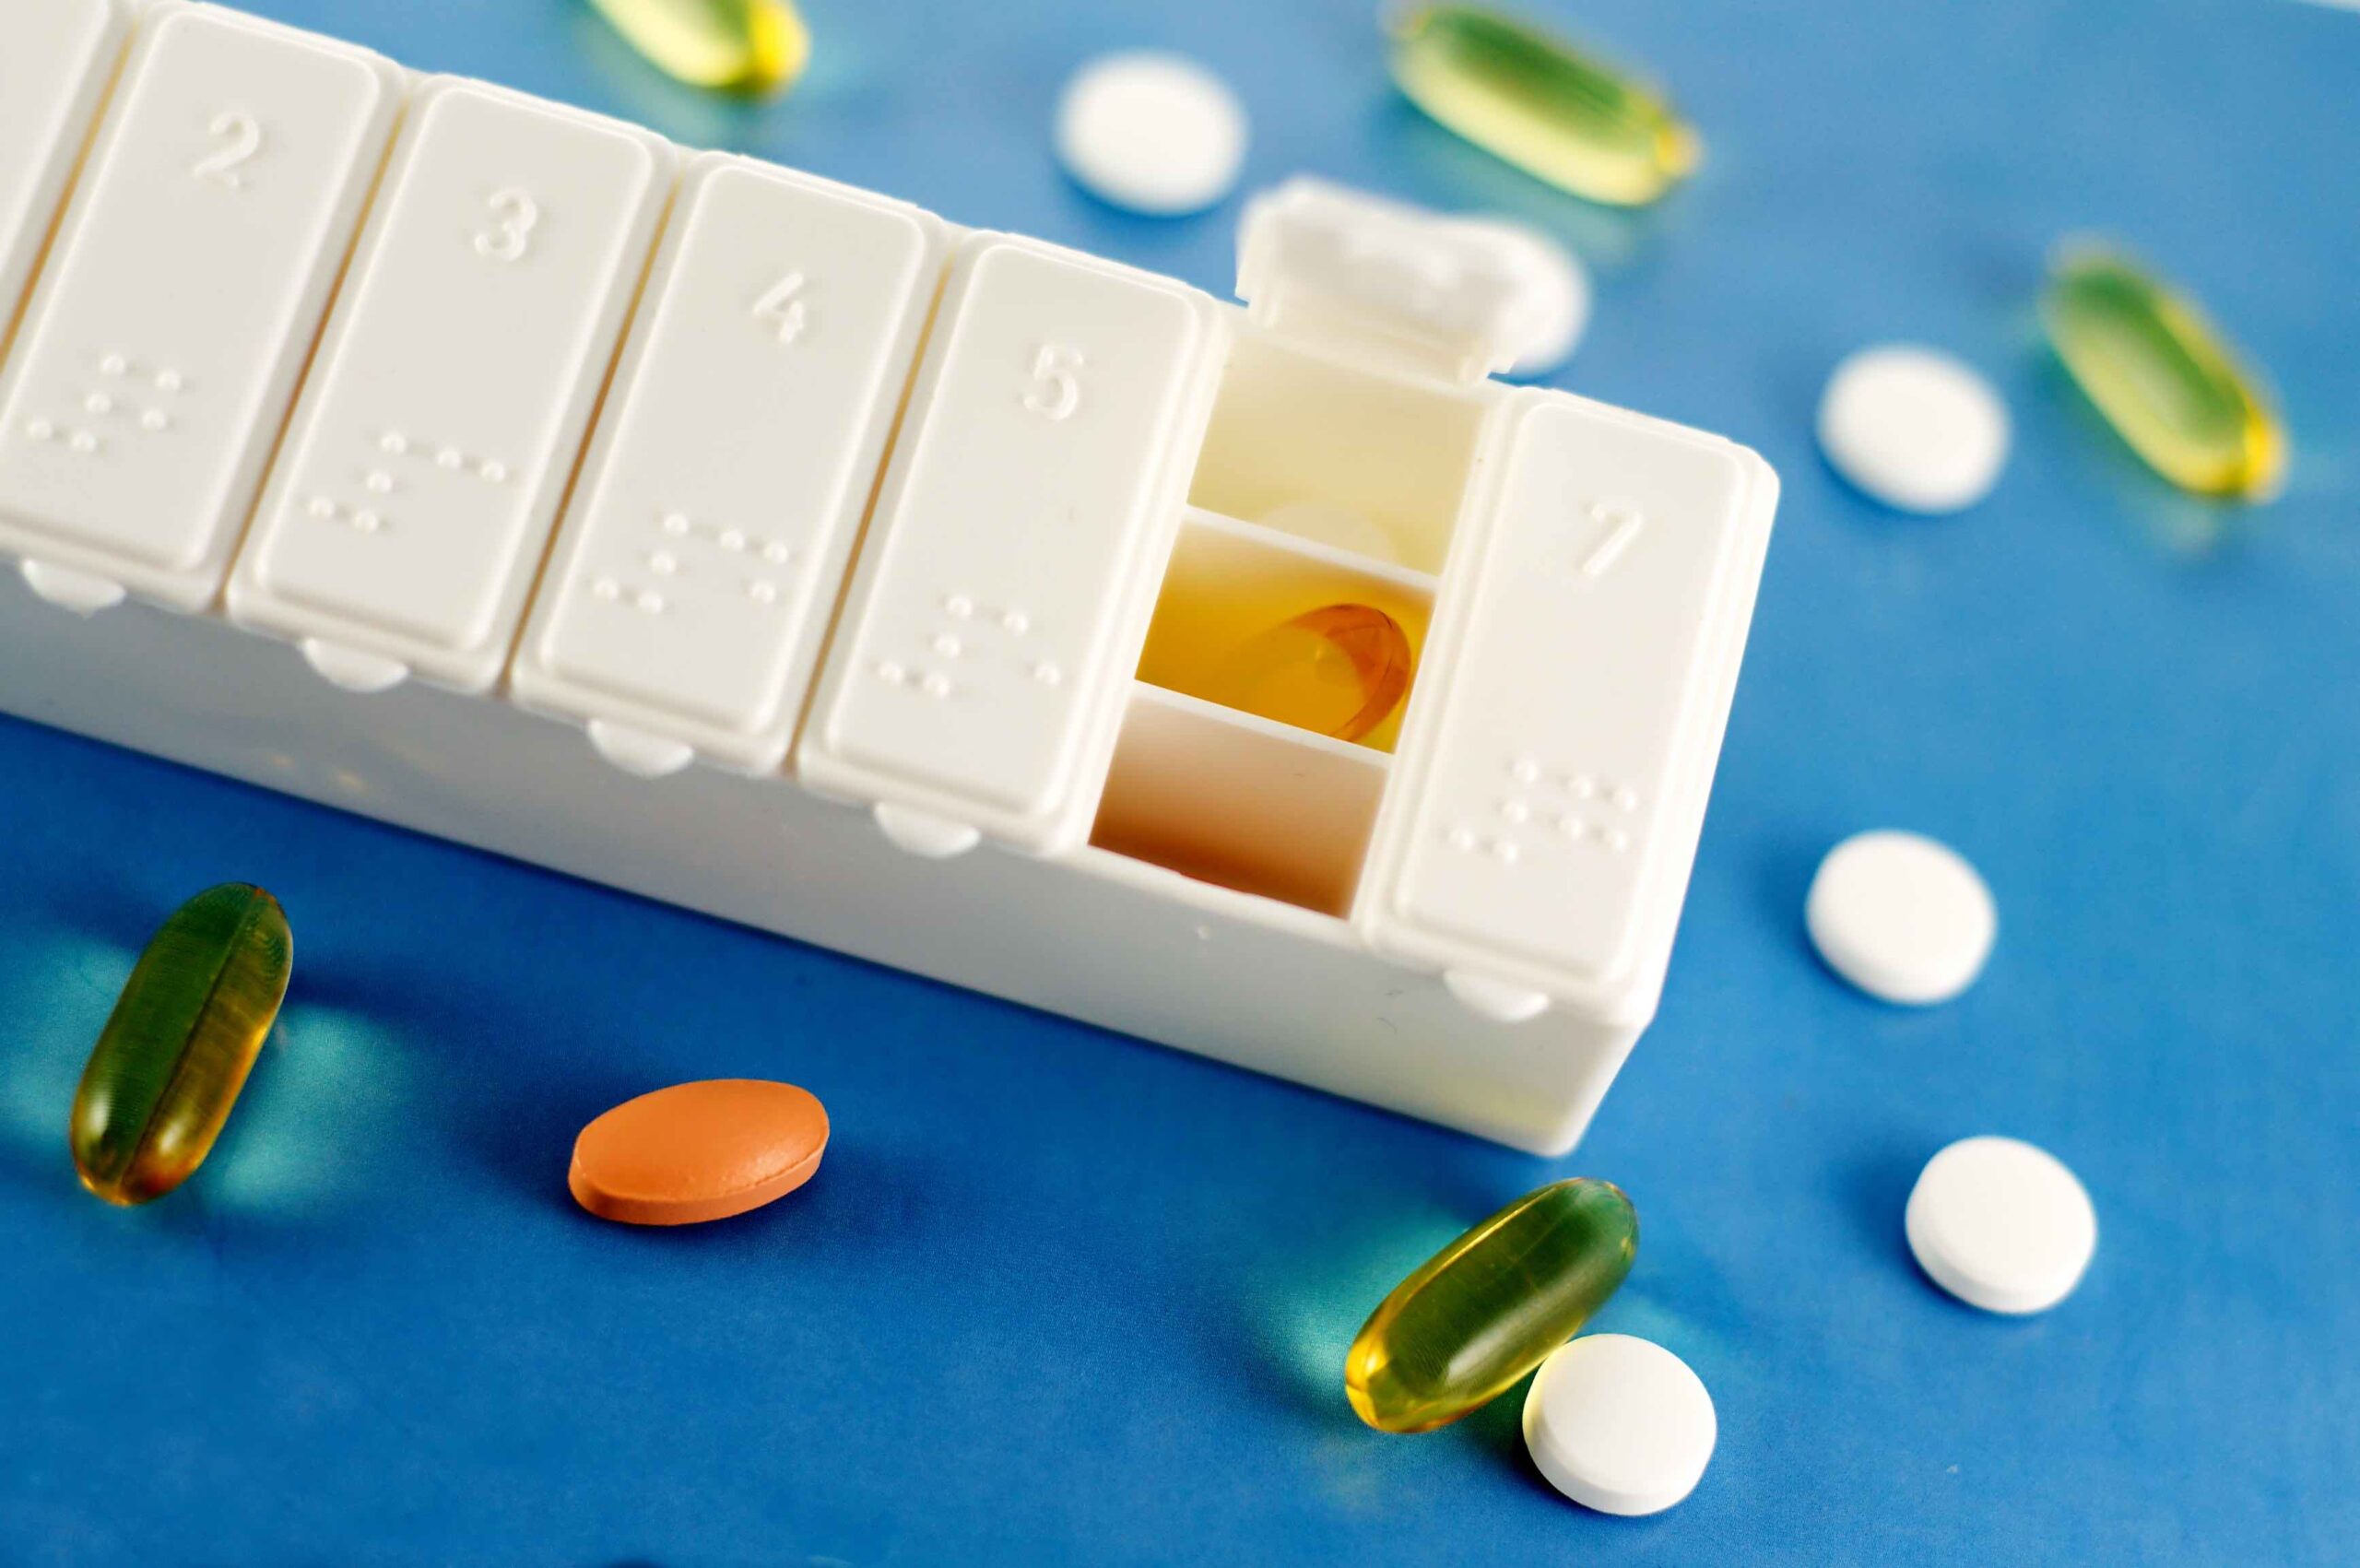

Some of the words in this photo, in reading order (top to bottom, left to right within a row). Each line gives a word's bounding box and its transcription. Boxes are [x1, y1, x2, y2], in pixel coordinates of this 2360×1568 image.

[193, 110, 261, 187] 2
[473, 188, 538, 262] 3
[752, 271, 806, 345] 4
[1023, 340, 1085, 422] 5
[1583, 500, 1644, 578] 7
